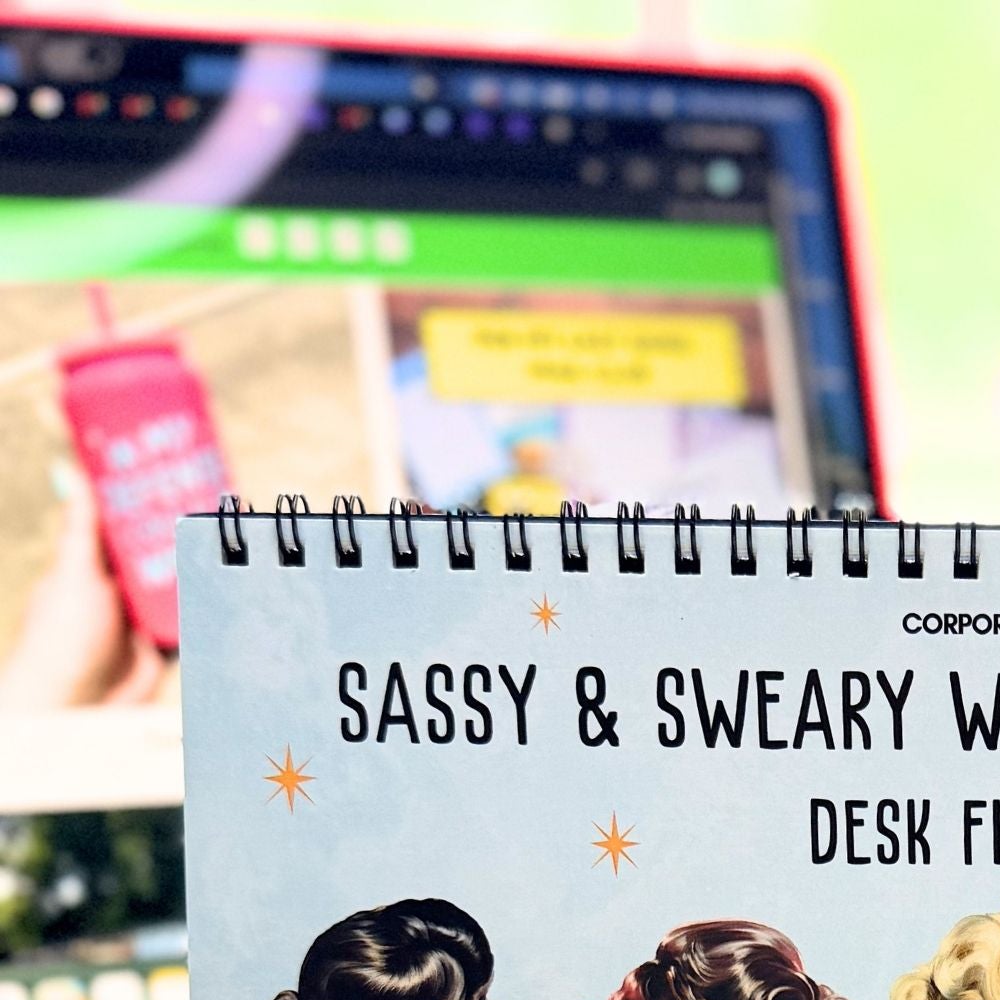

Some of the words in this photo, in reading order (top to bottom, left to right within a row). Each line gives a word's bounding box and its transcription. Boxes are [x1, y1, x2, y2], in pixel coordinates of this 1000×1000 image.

[338, 661, 537, 746] SASSY
[575, 666, 620, 748] &
[656, 667, 914, 751] SWEARY
[810, 798, 931, 865] DESK
